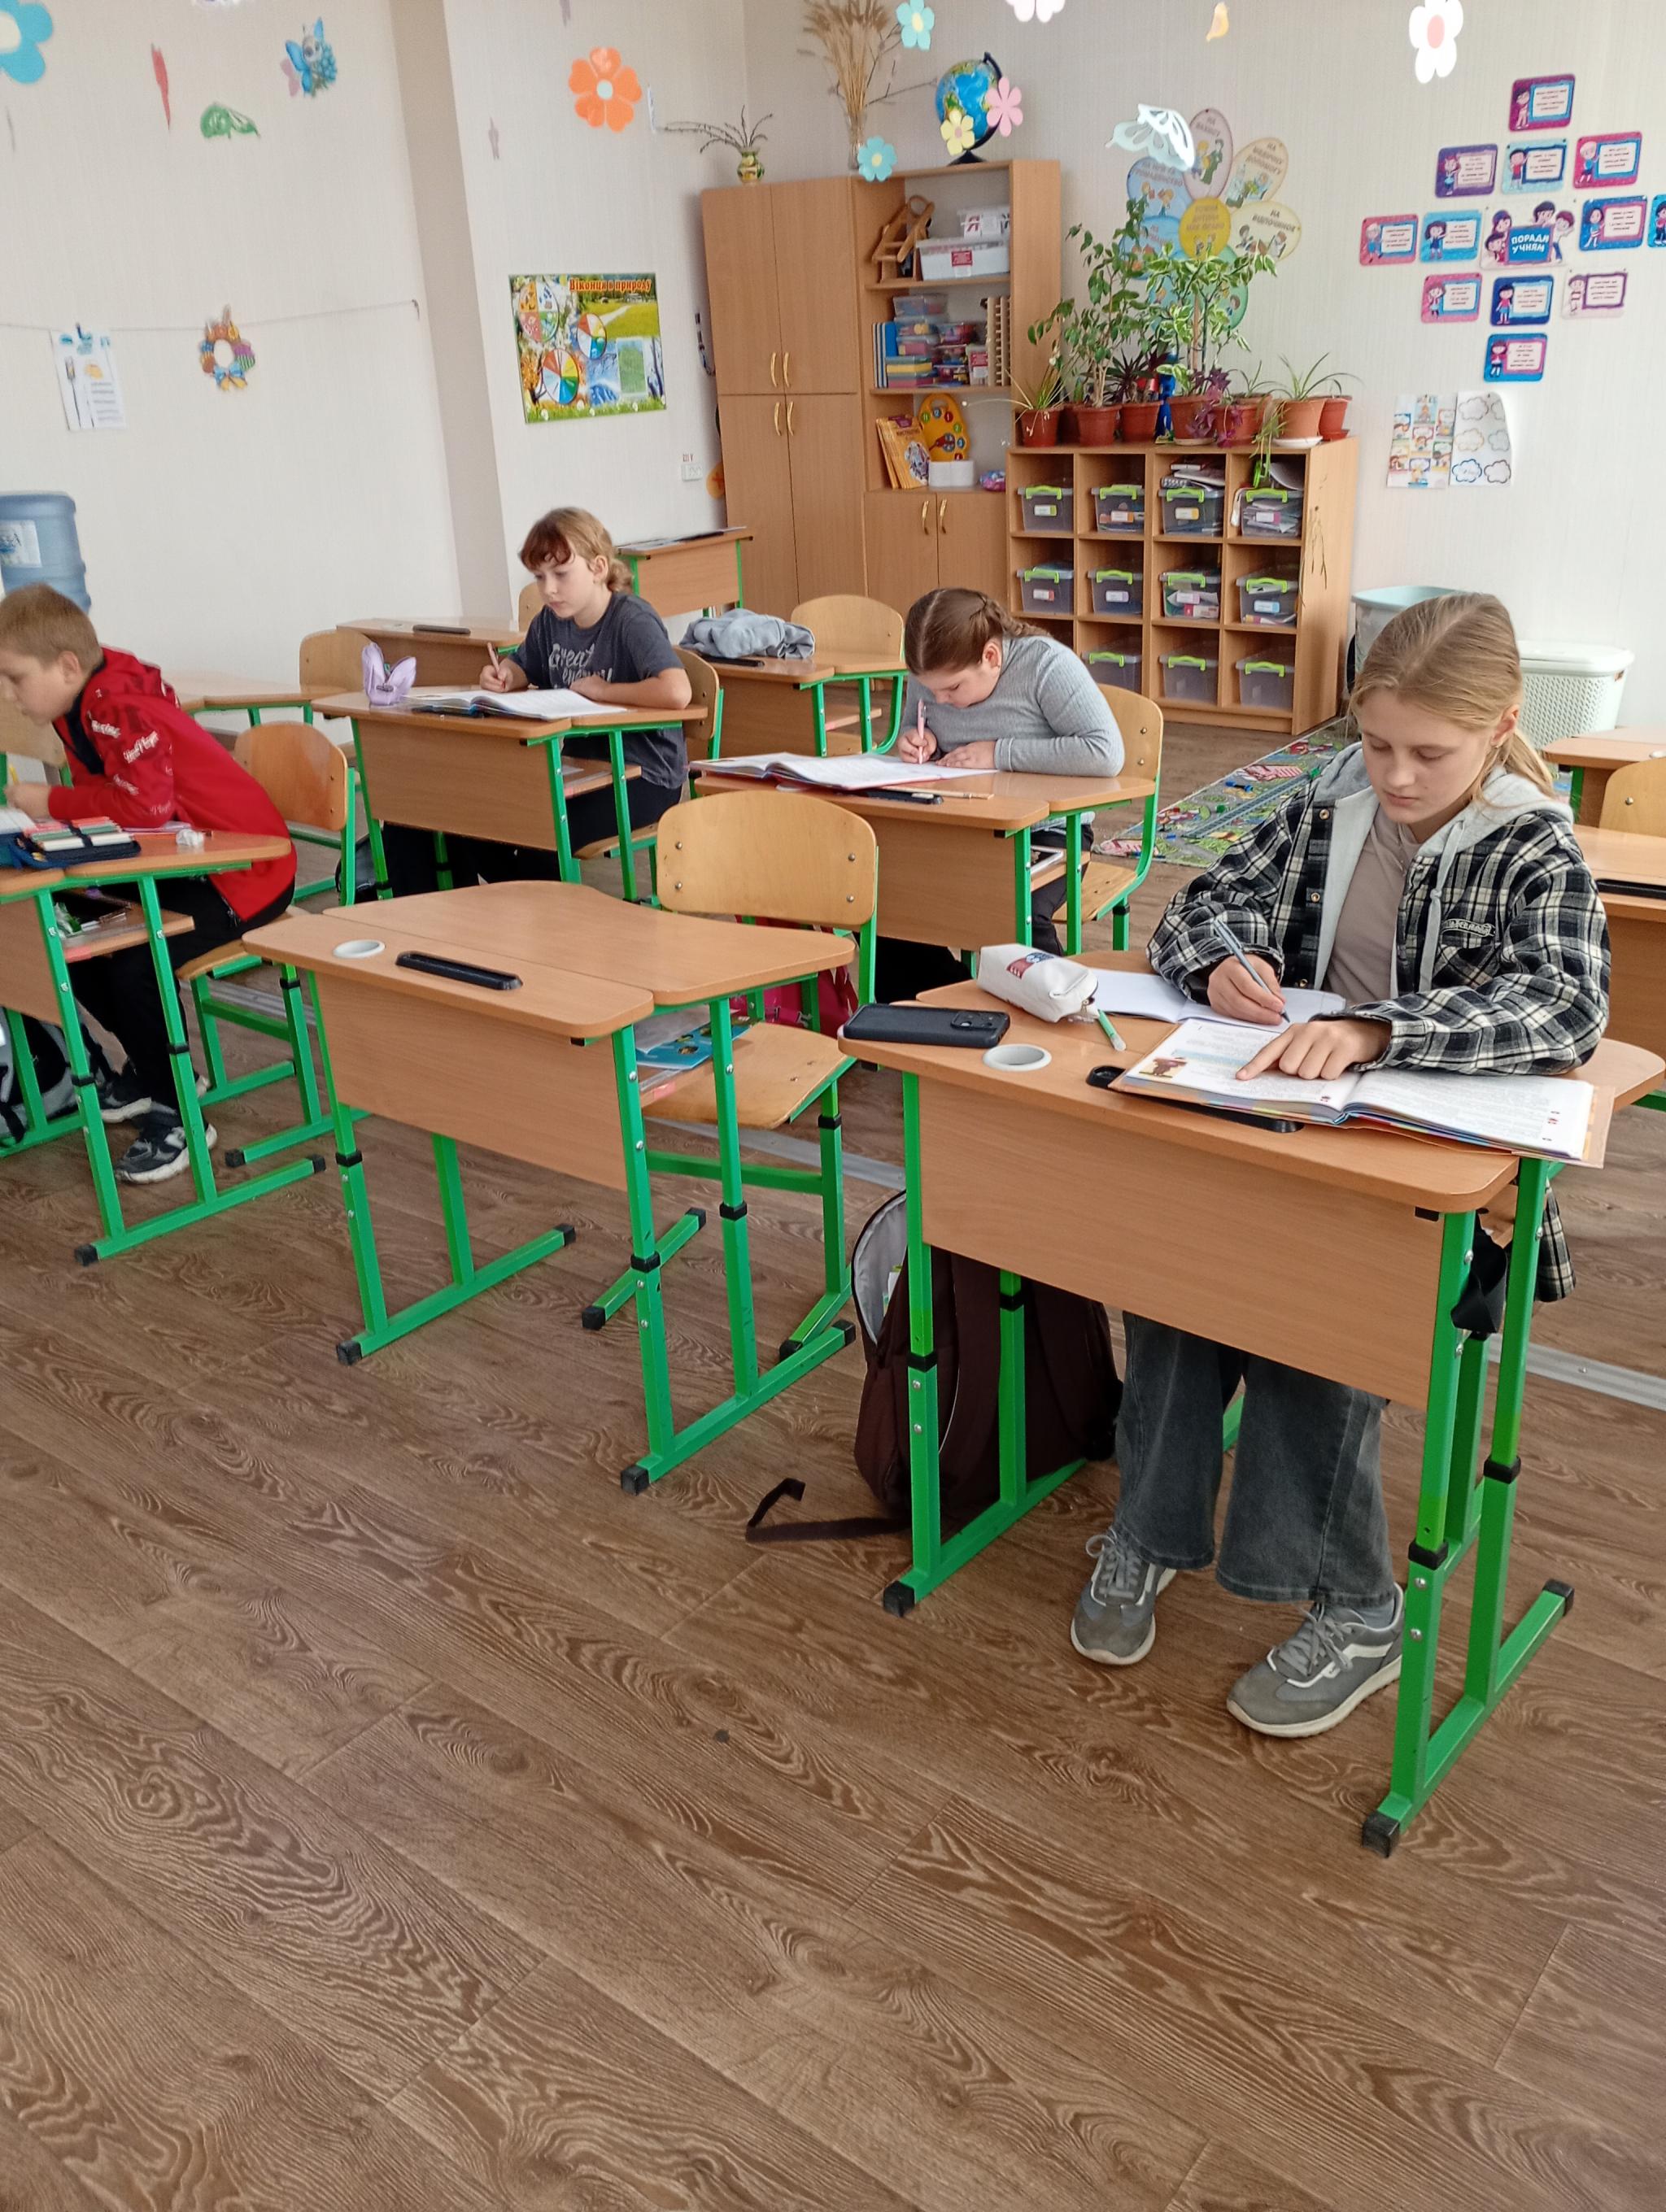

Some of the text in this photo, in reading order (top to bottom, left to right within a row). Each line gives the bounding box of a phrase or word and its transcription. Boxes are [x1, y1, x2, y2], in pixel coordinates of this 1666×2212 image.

[1511, 233, 1550, 244] ПОРАДИ
[1511, 243, 1546, 255] УЧНЯМ
[548, 642, 595, 671] Great
